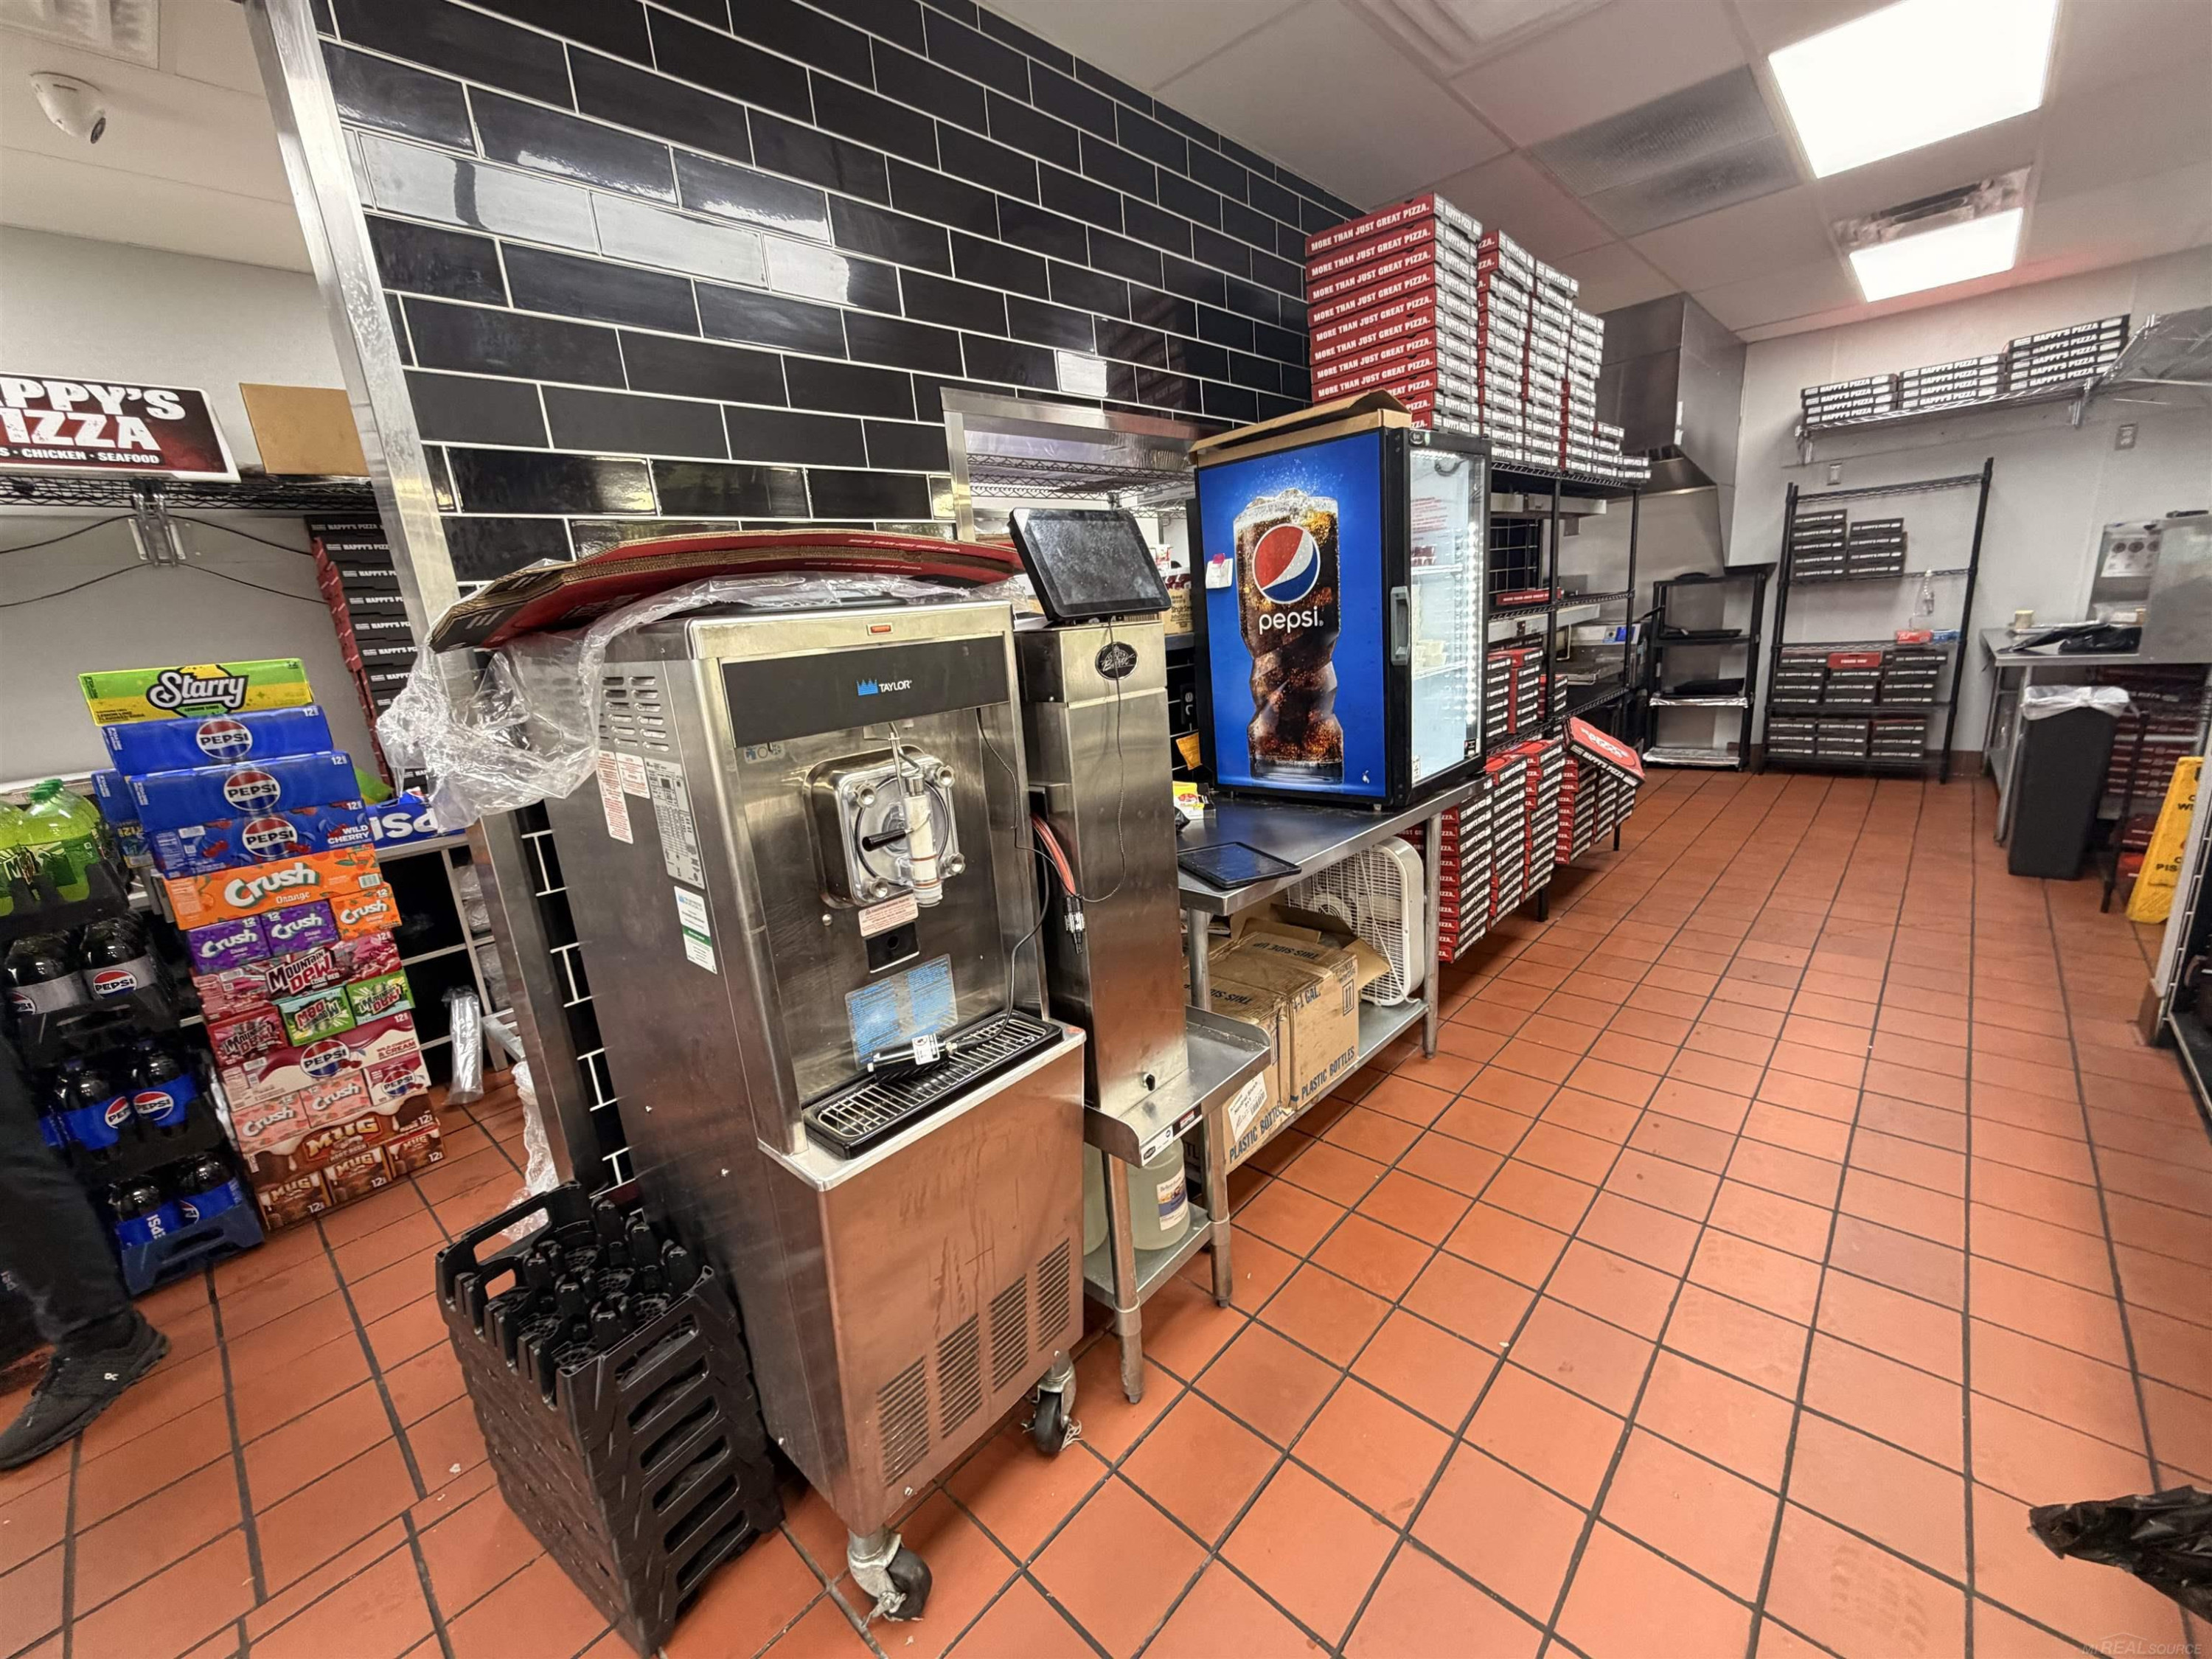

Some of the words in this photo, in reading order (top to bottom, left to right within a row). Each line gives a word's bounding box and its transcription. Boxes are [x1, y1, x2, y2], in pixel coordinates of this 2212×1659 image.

[1311, 237, 1332, 251] MORE
[1333, 229, 1353, 243] THAN
[1355, 222, 1374, 235] JUST
[1377, 212, 1400, 227] GREAT
[1403, 204, 1429, 219] PIZZA.
[1312, 262, 1332, 276] MORE
[1334, 254, 1354, 268] THAN
[1356, 246, 1375, 260] JUST
[1377, 237, 1401, 253] GREAT
[1404, 229, 1430, 244] PIZZA.
[1312, 285, 1333, 299] MORE
[1335, 277, 1355, 291] THAN
[1357, 270, 1376, 283] JUST
[1378, 260, 1402, 275] GREAT
[1405, 251, 1430, 266] PIZZA.
[1314, 308, 1334, 321] MORE
[1336, 300, 1355, 314] THAN
[1357, 293, 1376, 306] JUST
[1378, 283, 1402, 298] GREAT
[1405, 274, 1430, 288] PIZZA.
[1316, 328, 1337, 341] MORE
[1338, 321, 1358, 334] THAN
[1360, 313, 1378, 326] JUST
[1380, 304, 1404, 319] GREAT
[1407, 296, 1432, 310] PIZZA.
[1315, 347, 1335, 360] MORE
[1337, 339, 1357, 352] THAN
[1358, 332, 1377, 346] JUST
[1379, 323, 1402, 338] GREAT
[1405, 316, 1430, 330] PIZZA.
[2034, 329, 2070, 342] HAPPY'S
[2072, 323, 2098, 333] PIZZA
[2032, 341, 2069, 354] HAPPY'S
[2070, 334, 2097, 345] PIZZA
[1317, 365, 1337, 378] MORE
[1339, 358, 1358, 372] THAN
[1360, 352, 1379, 365] JUST
[1381, 345, 1405, 358] GREAT
[1407, 338, 1432, 351] PIZZA.
[2032, 351, 2069, 365] HAPPY'S
[2070, 346, 2098, 357] PIZZA
[2030, 362, 2067, 375] HAPPY'S
[2068, 356, 2096, 367] PIZZA
[1318, 384, 1338, 397] MORE
[1340, 378, 1359, 390] THAN
[1361, 372, 1380, 384] JUST
[1382, 364, 1405, 378] GREAT
[1408, 358, 1433, 372] PIZZA.
[1408, 379, 1433, 392] PIZZA.
[2029, 372, 2066, 386] HAPPY'S
[2067, 368, 2094, 378] PIZZA
[0, 378, 185, 420] PPY'S
[0, 408, 161, 451] IZZA
[21, 448, 87, 460] CHICKEN
[97, 451, 160, 464] SEAFOOD
[1259, 607, 1320, 634] pepsi
[149, 671, 245, 709] Starry
[879, 680, 910, 692] TAYLOR
[303, 708, 313, 717] 12
[200, 732, 249, 745] PEPSI
[332, 757, 343, 765] 12
[1582, 751, 1608, 768] HAPPY'S
[1606, 765, 1625, 779] PIZZA
[228, 784, 276, 798] PEPSI
[347, 800, 358, 810] 12
[342, 824, 368, 835] WILD
[369, 807, 438, 841] psi
[246, 830, 294, 845] PEPSI
[327, 832, 369, 845] CHERRY
[2156, 863, 2177, 872] PIS
[224, 862, 316, 907] Crush
[377, 888, 388, 897] 12
[276, 891, 310, 905] Orange
[243, 917, 257, 926] 12
[268, 912, 280, 921] 12
[340, 900, 388, 925] Crush
[271, 913, 322, 939] Crush
[200, 929, 258, 956] Crush
[1253, 942, 1269, 950] UP
[1270, 944, 1294, 956] SIDE
[1294, 950, 1319, 959] THIS
[95, 978, 133, 992] PEPSI
[1304, 985, 1321, 1004] GAL.
[1226, 992, 1253, 1005] THIS
[304, 1048, 348, 1068] PEPSI
[385, 1041, 416, 1056] CREAM
[1301, 1070, 1327, 1100] PLASTIC
[1329, 1046, 1354, 1079] BOTTLES
[383, 1076, 414, 1091] PEPSI
[312, 1082, 360, 1110] Crush
[242, 1107, 293, 1136] Crush
[306, 1117, 380, 1156] MUG
[403, 1135, 428, 1150] MUG
[1229, 1127, 1258, 1164] PLASTIC
[336, 1154, 373, 1176] MUG
[428, 1152, 439, 1163] 12
[271, 1178, 311, 1202] MUG
[372, 1178, 383, 1189] 12
[307, 1202, 321, 1214] 12
